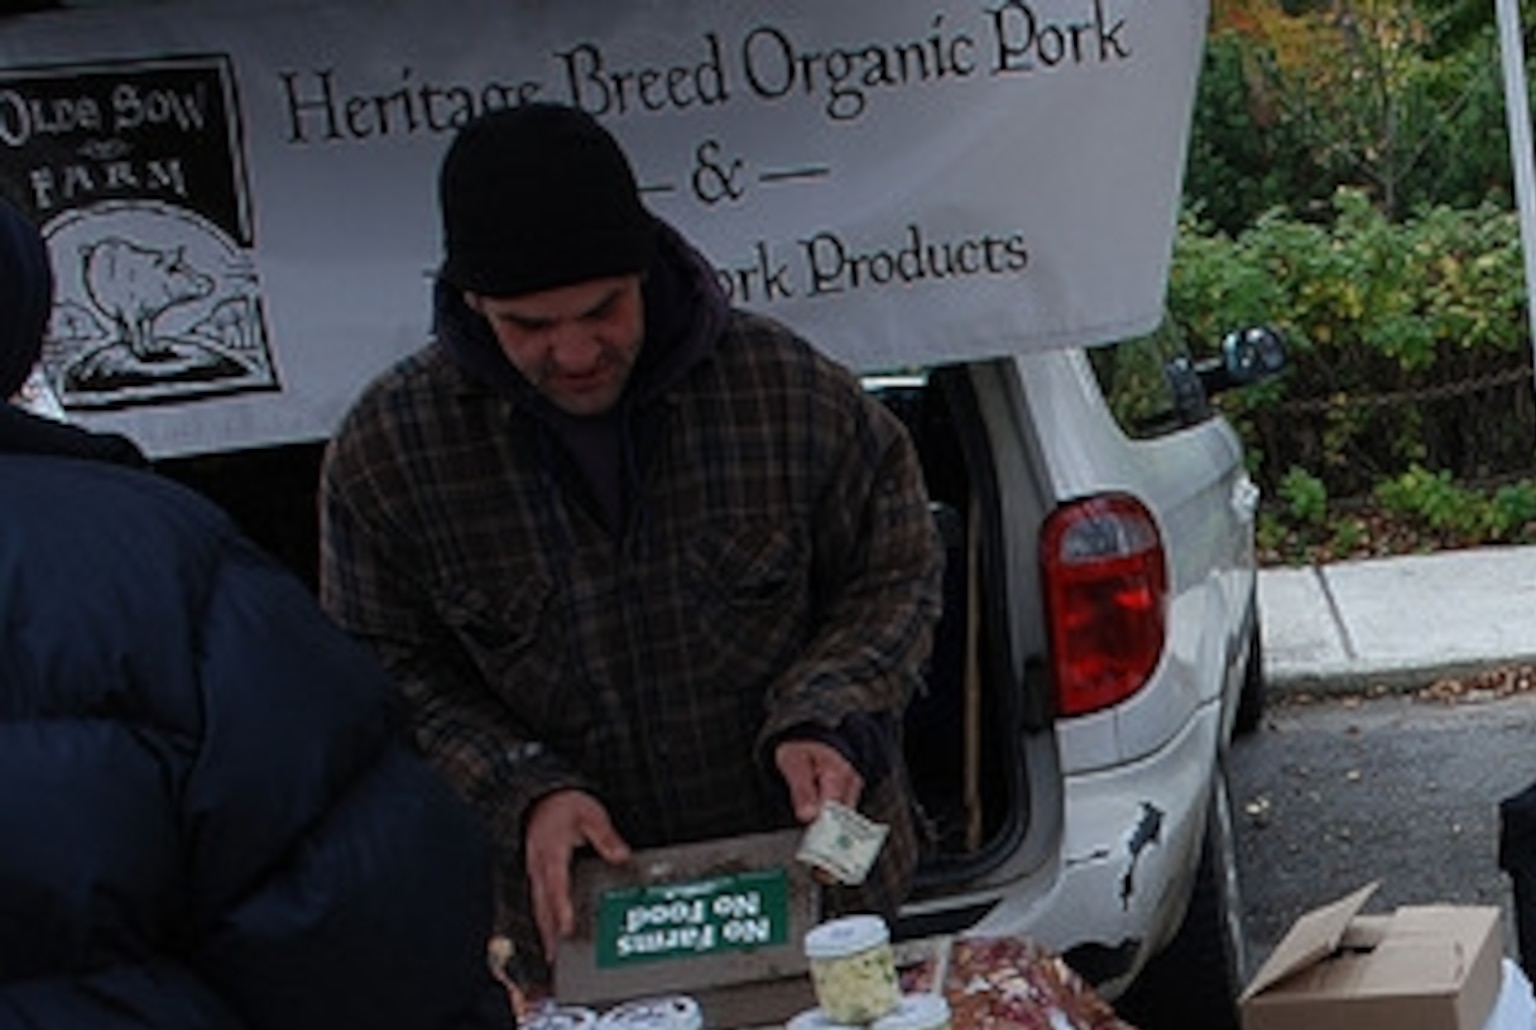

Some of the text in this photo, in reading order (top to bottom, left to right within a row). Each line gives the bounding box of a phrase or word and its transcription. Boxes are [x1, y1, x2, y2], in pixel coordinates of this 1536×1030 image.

[552, 33, 729, 117] Breed
[742, 15, 975, 120] Organic
[986, 0, 1132, 74] Pork
[691, 140, 746, 204] &
[716, 224, 1029, 301] ork Products
[616, 916, 771, 957] No Farms
[625, 889, 761, 933] No Food
